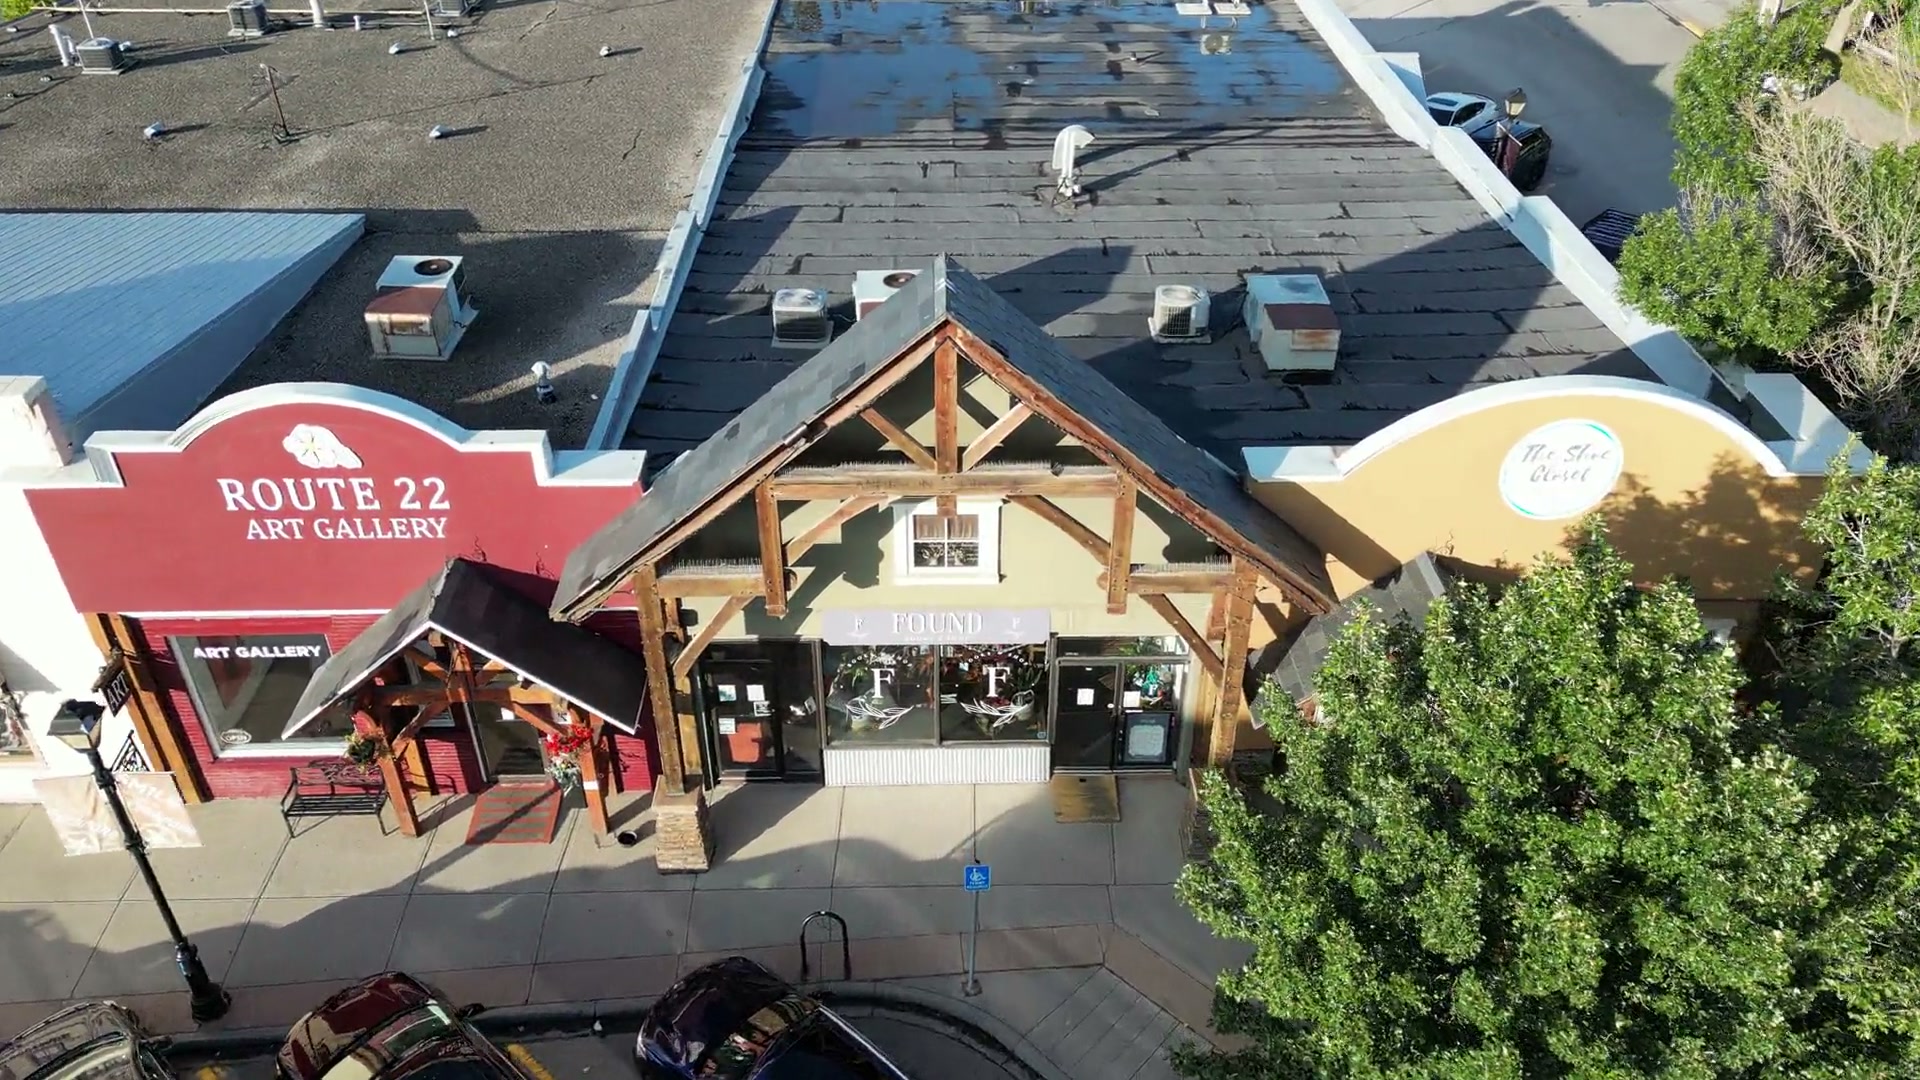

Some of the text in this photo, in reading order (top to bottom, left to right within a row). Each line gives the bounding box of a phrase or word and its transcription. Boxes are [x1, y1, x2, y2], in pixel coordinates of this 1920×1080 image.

[1521, 443, 1555, 463] The
[217, 477, 451, 511] ROUTE 22
[246, 517, 448, 540] ART GALLERY
[891, 612, 984, 635] FOUND
[193, 645, 322, 659] ART GALLERY
[106, 670, 130, 712] ART
[870, 668, 896, 699] F
[986, 666, 1011, 697] F
